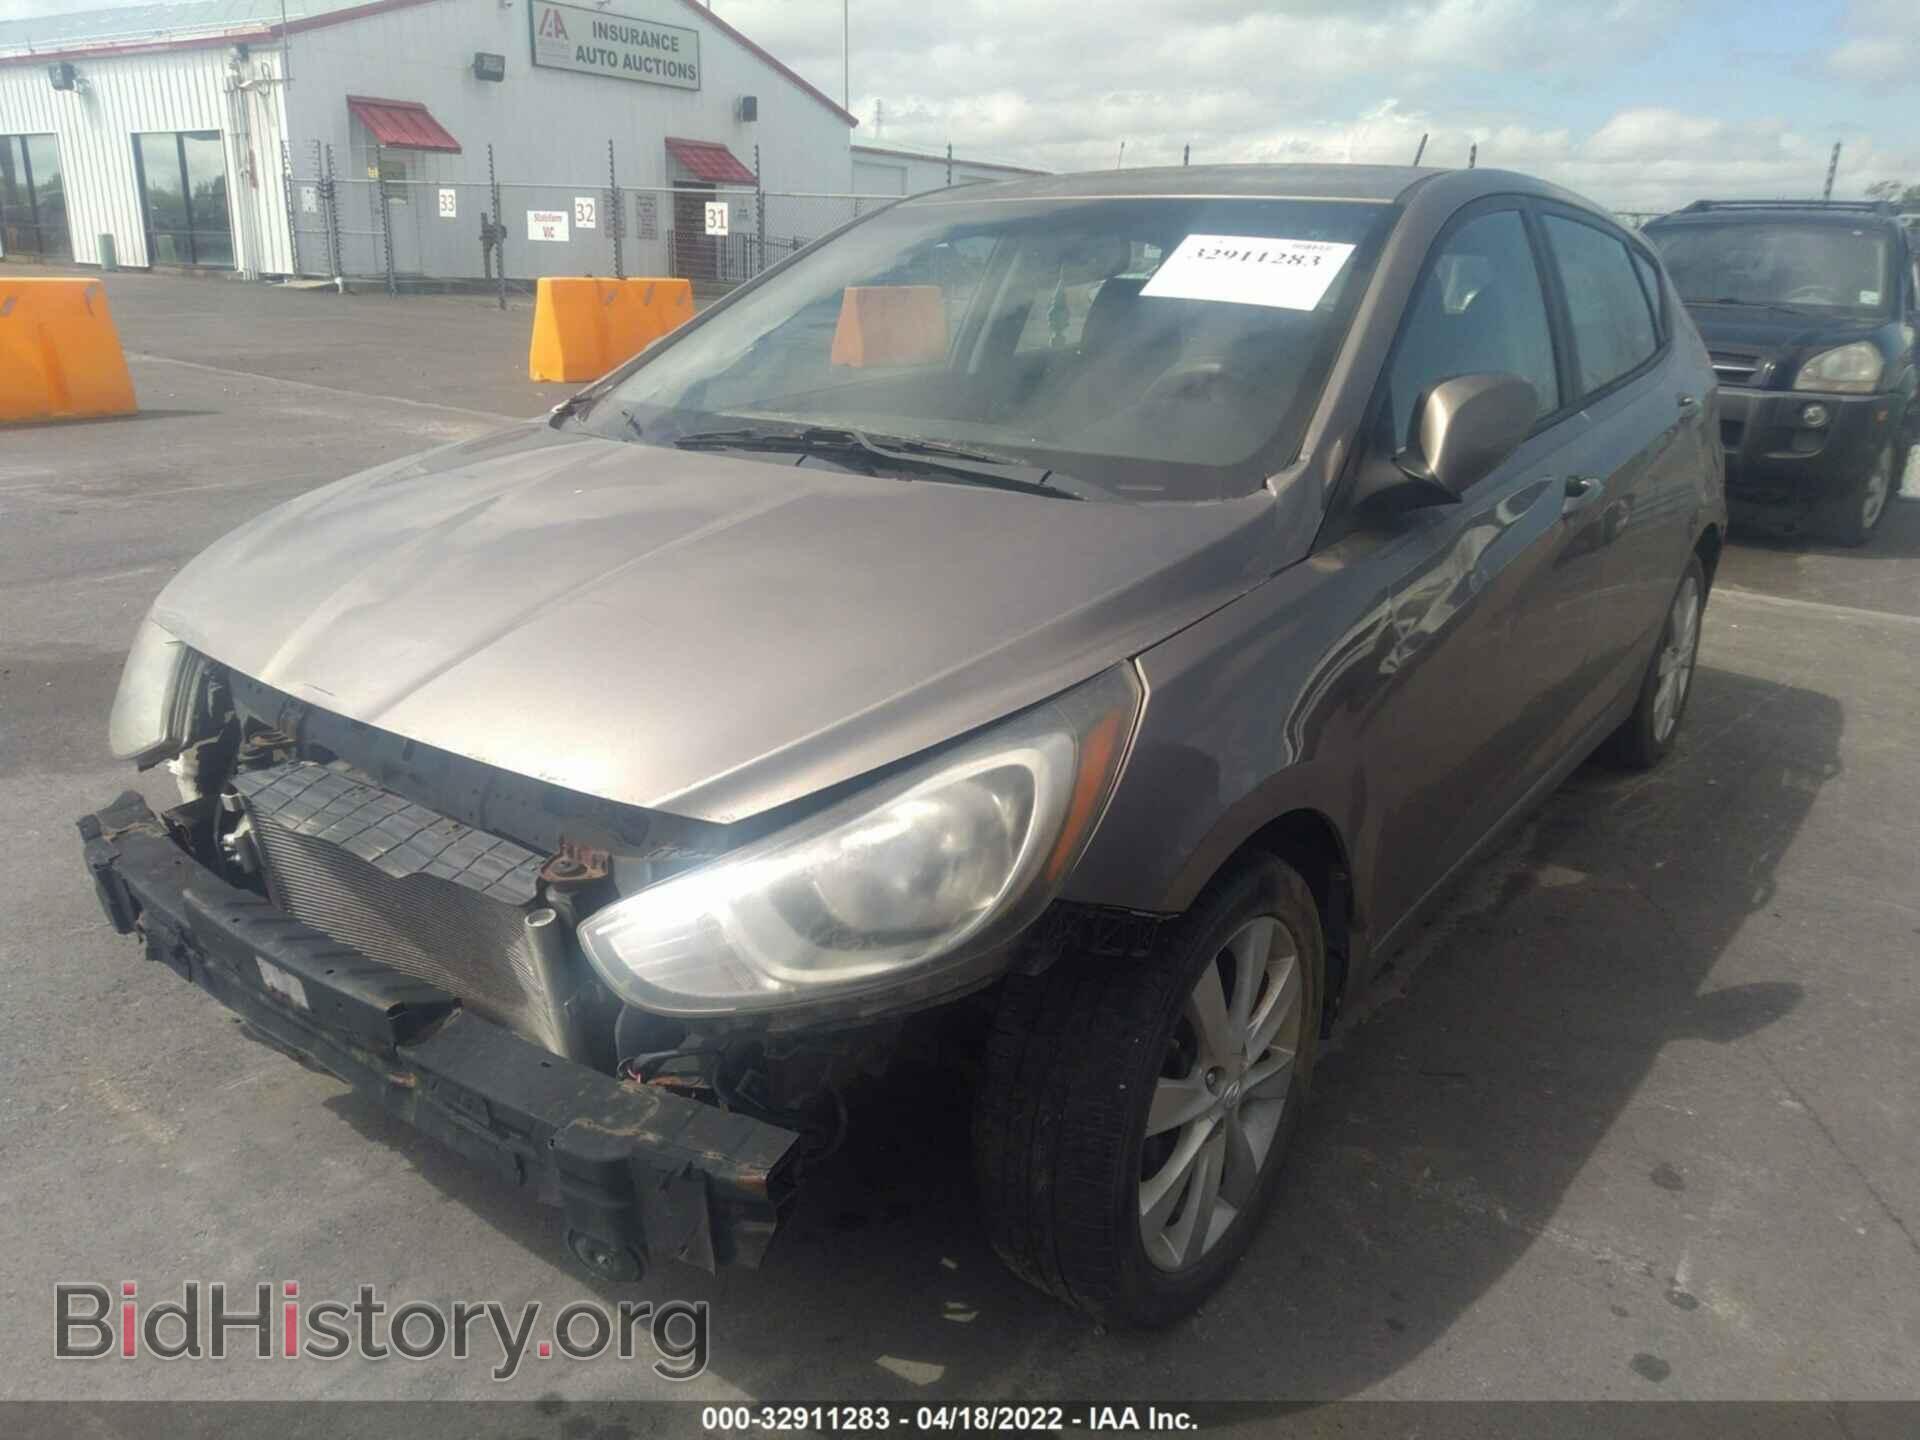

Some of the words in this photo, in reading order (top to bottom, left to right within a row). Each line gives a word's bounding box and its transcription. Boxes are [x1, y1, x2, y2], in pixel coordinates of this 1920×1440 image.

[592, 20, 679, 52] INSURANCE
[575, 45, 618, 68] AUTO
[622, 56, 697, 81] AUCTIONS
[440, 194, 454, 212] 33
[576, 203, 594, 223] 32
[707, 208, 727, 230] 31
[1195, 248, 1322, 267] 32911283
